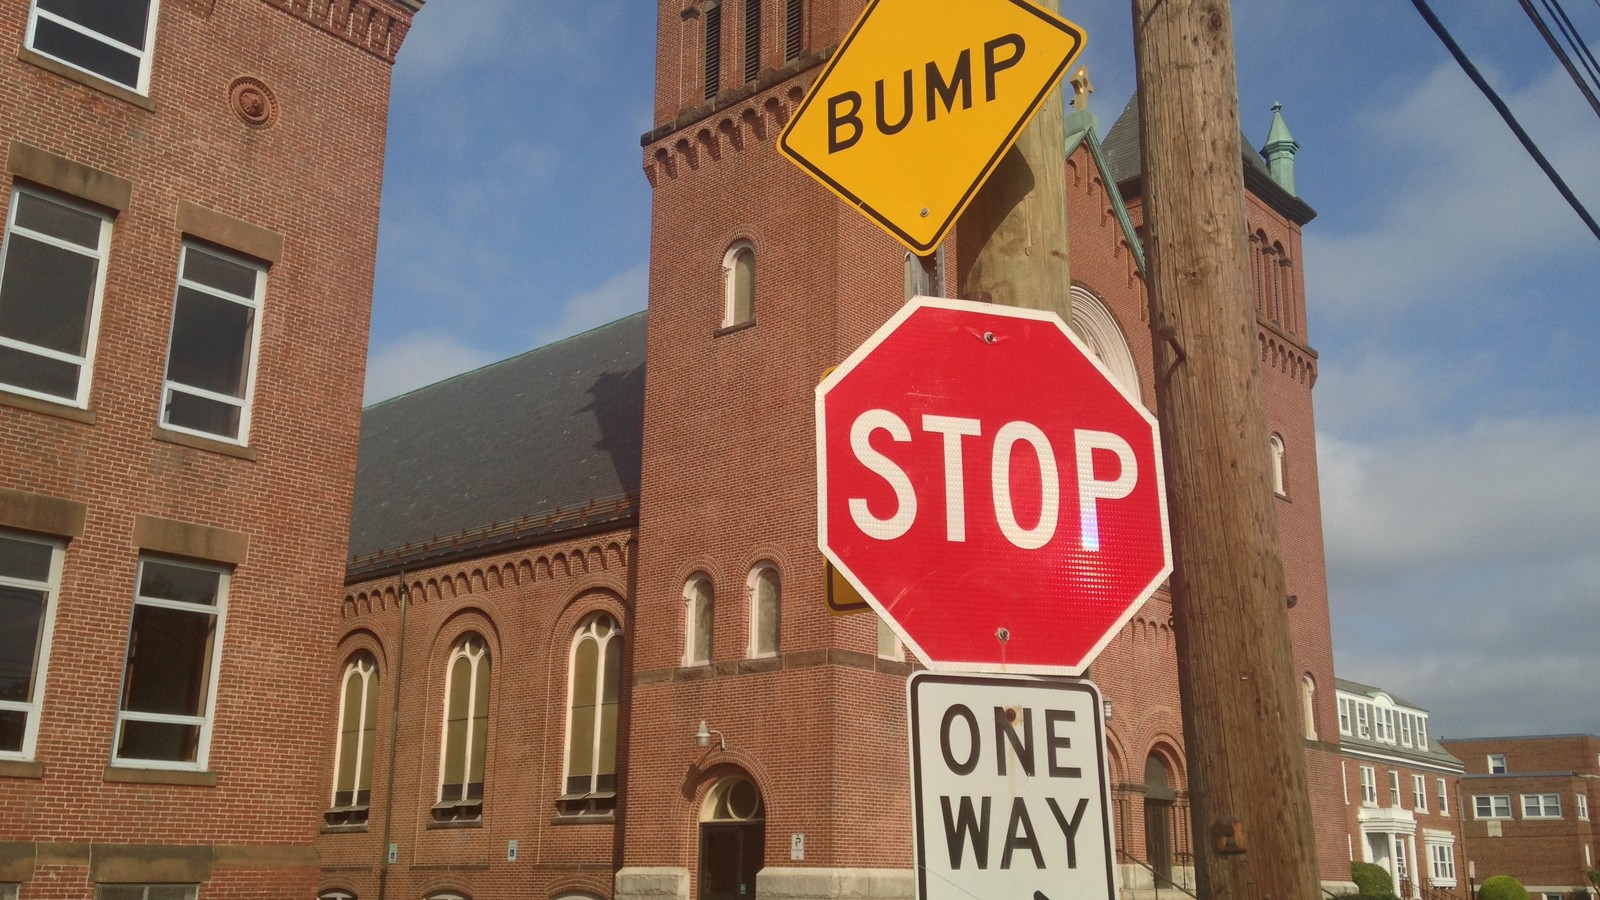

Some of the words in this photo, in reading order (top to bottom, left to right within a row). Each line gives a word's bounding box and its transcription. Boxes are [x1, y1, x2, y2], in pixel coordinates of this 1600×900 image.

[827, 33, 1026, 155] BUMP
[848, 408, 1138, 552] STOP
[940, 703, 1082, 778] ONE
[940, 796, 1090, 870] WAY
